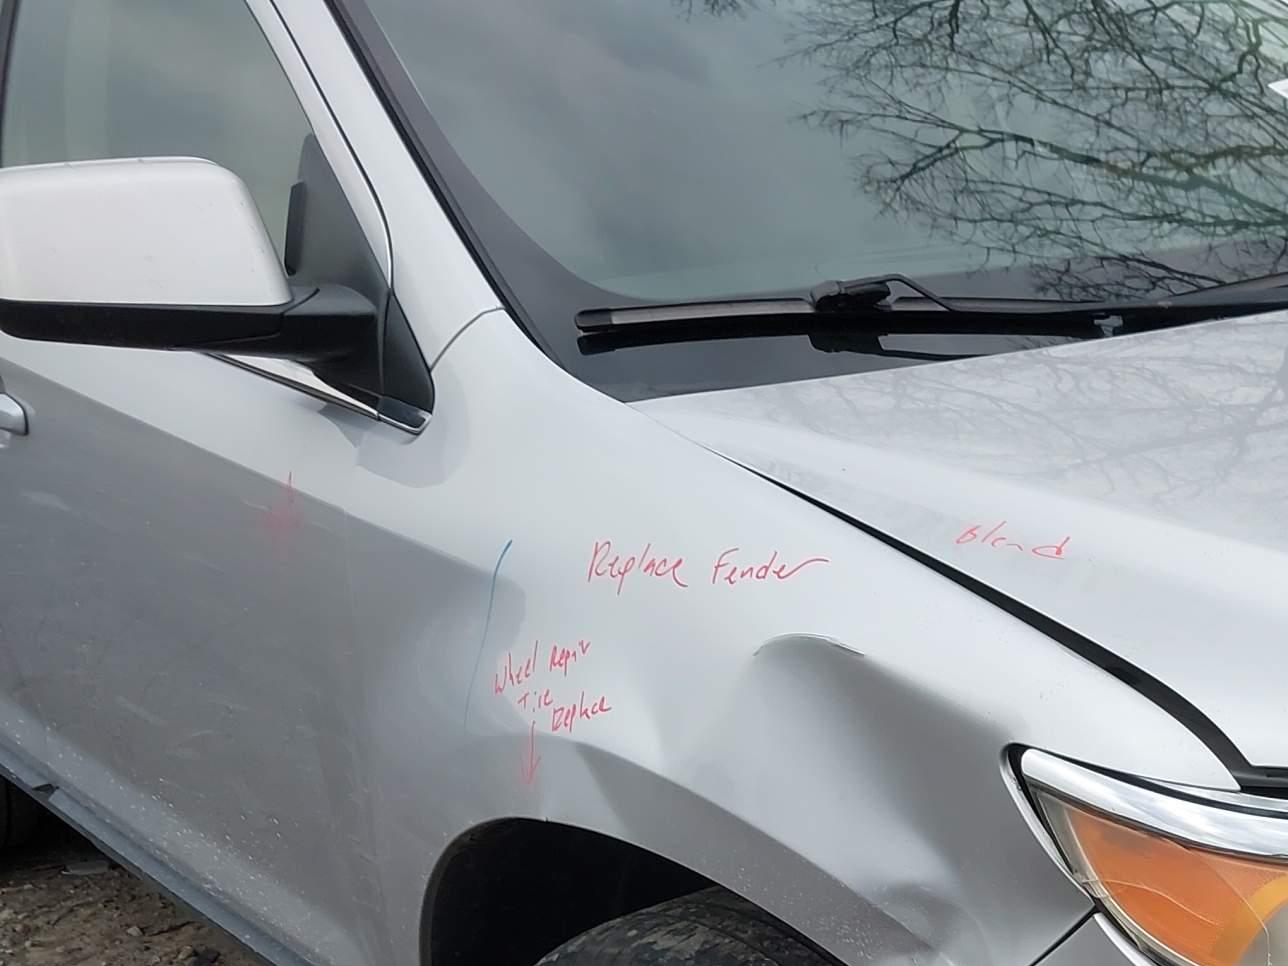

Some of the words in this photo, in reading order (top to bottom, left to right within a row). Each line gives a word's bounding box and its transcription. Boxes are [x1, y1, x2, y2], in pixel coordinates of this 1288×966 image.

[588, 541, 688, 595] Replace
[711, 548, 829, 585] Fender
[494, 640, 538, 695] Wheel
[552, 691, 612, 733] Replace
